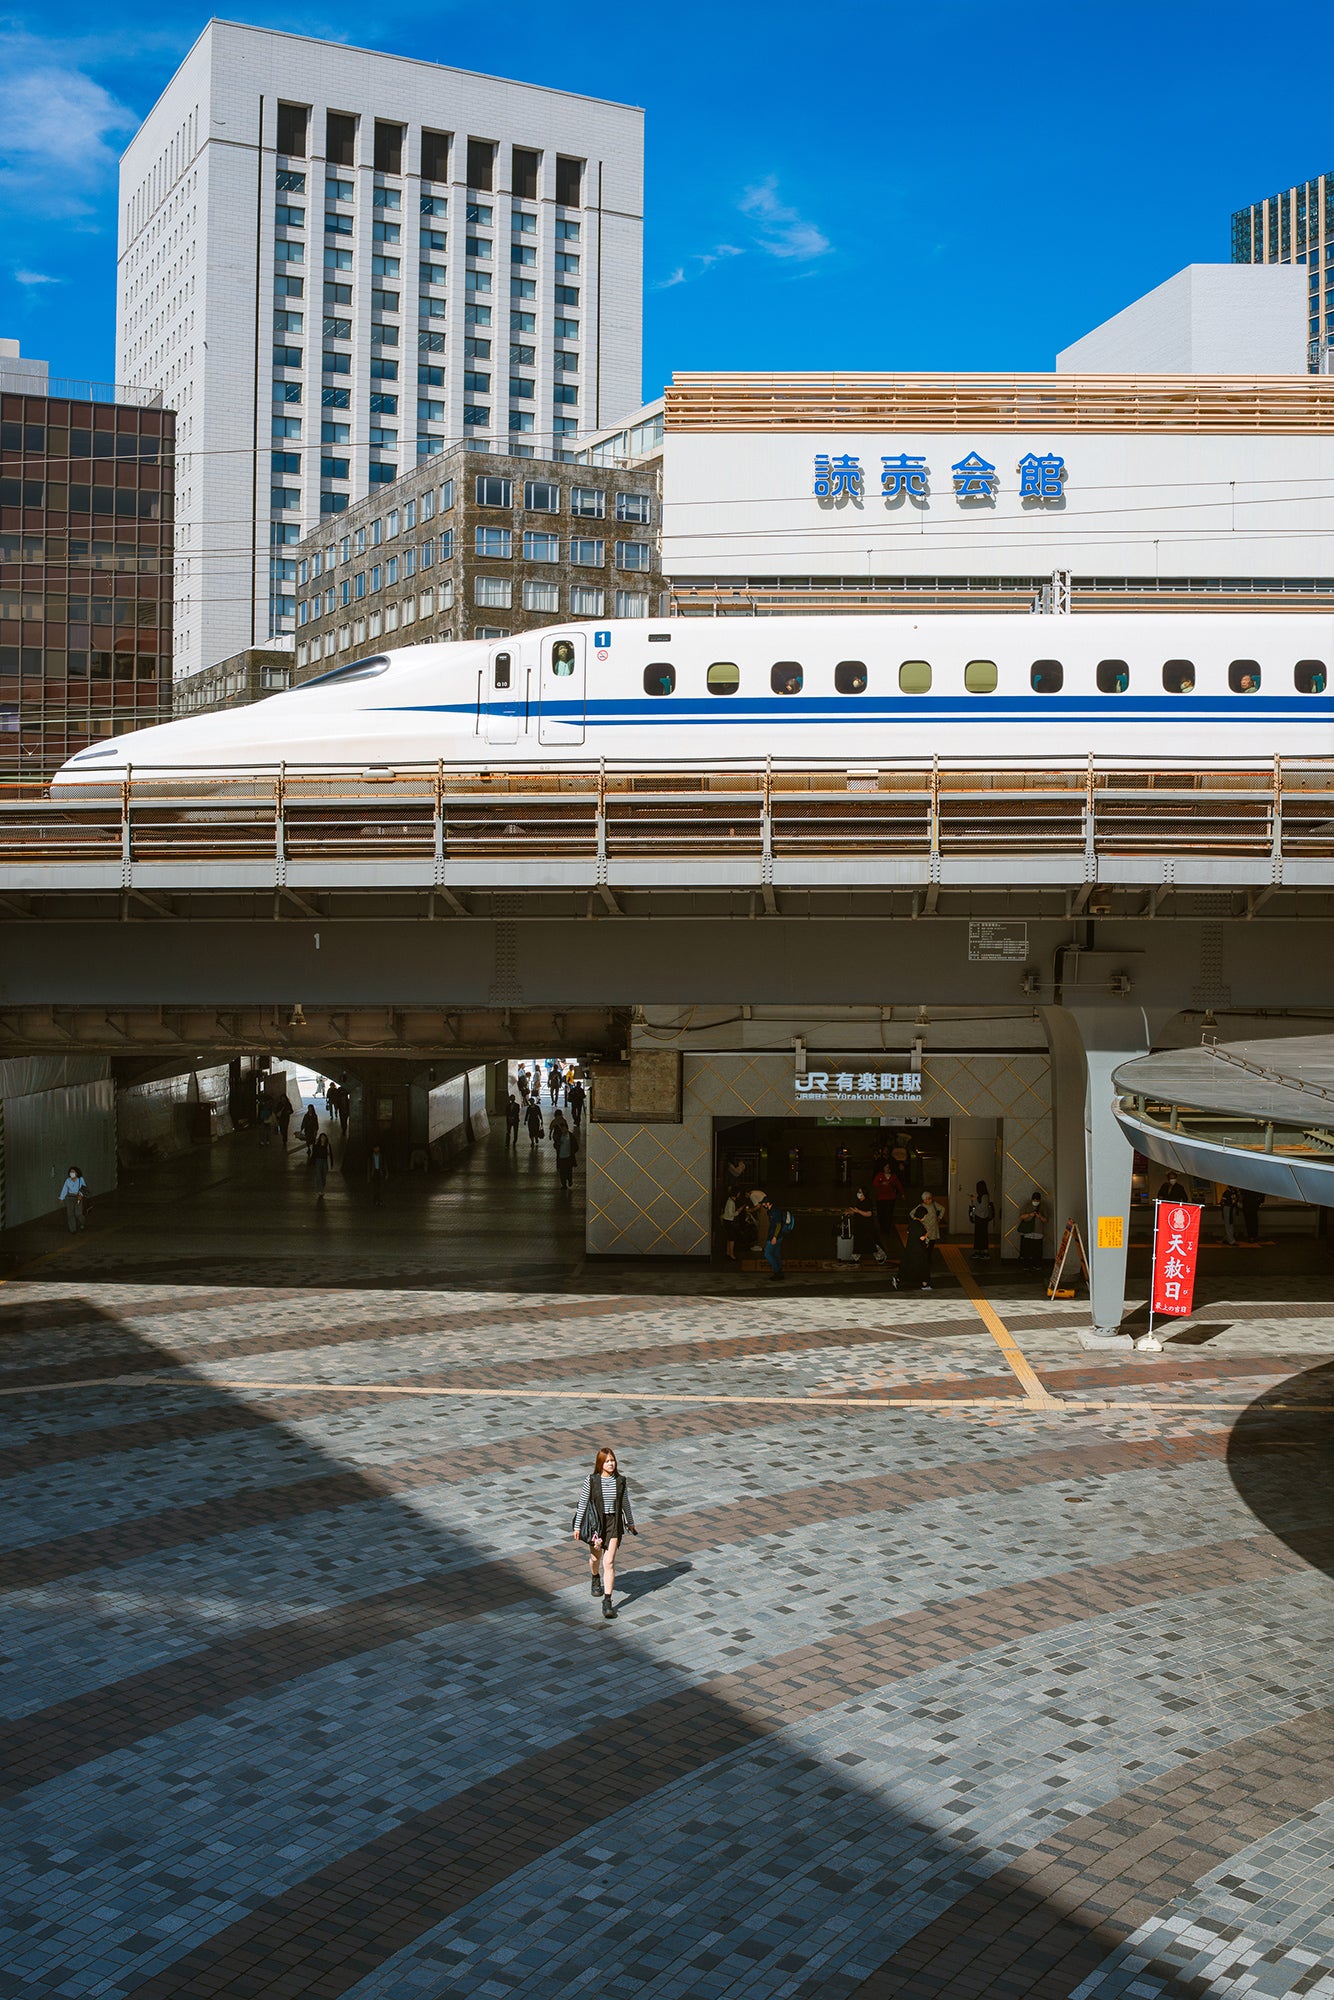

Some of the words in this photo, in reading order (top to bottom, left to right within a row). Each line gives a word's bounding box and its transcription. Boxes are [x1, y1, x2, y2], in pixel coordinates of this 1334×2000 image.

[814, 450, 1065, 498] 読売会館
[598, 633, 606, 646] 1
[795, 1072, 829, 1092] JR
[835, 1072, 922, 1092] 有楽町駅
[1164, 1233, 1187, 1301] 天赦日
